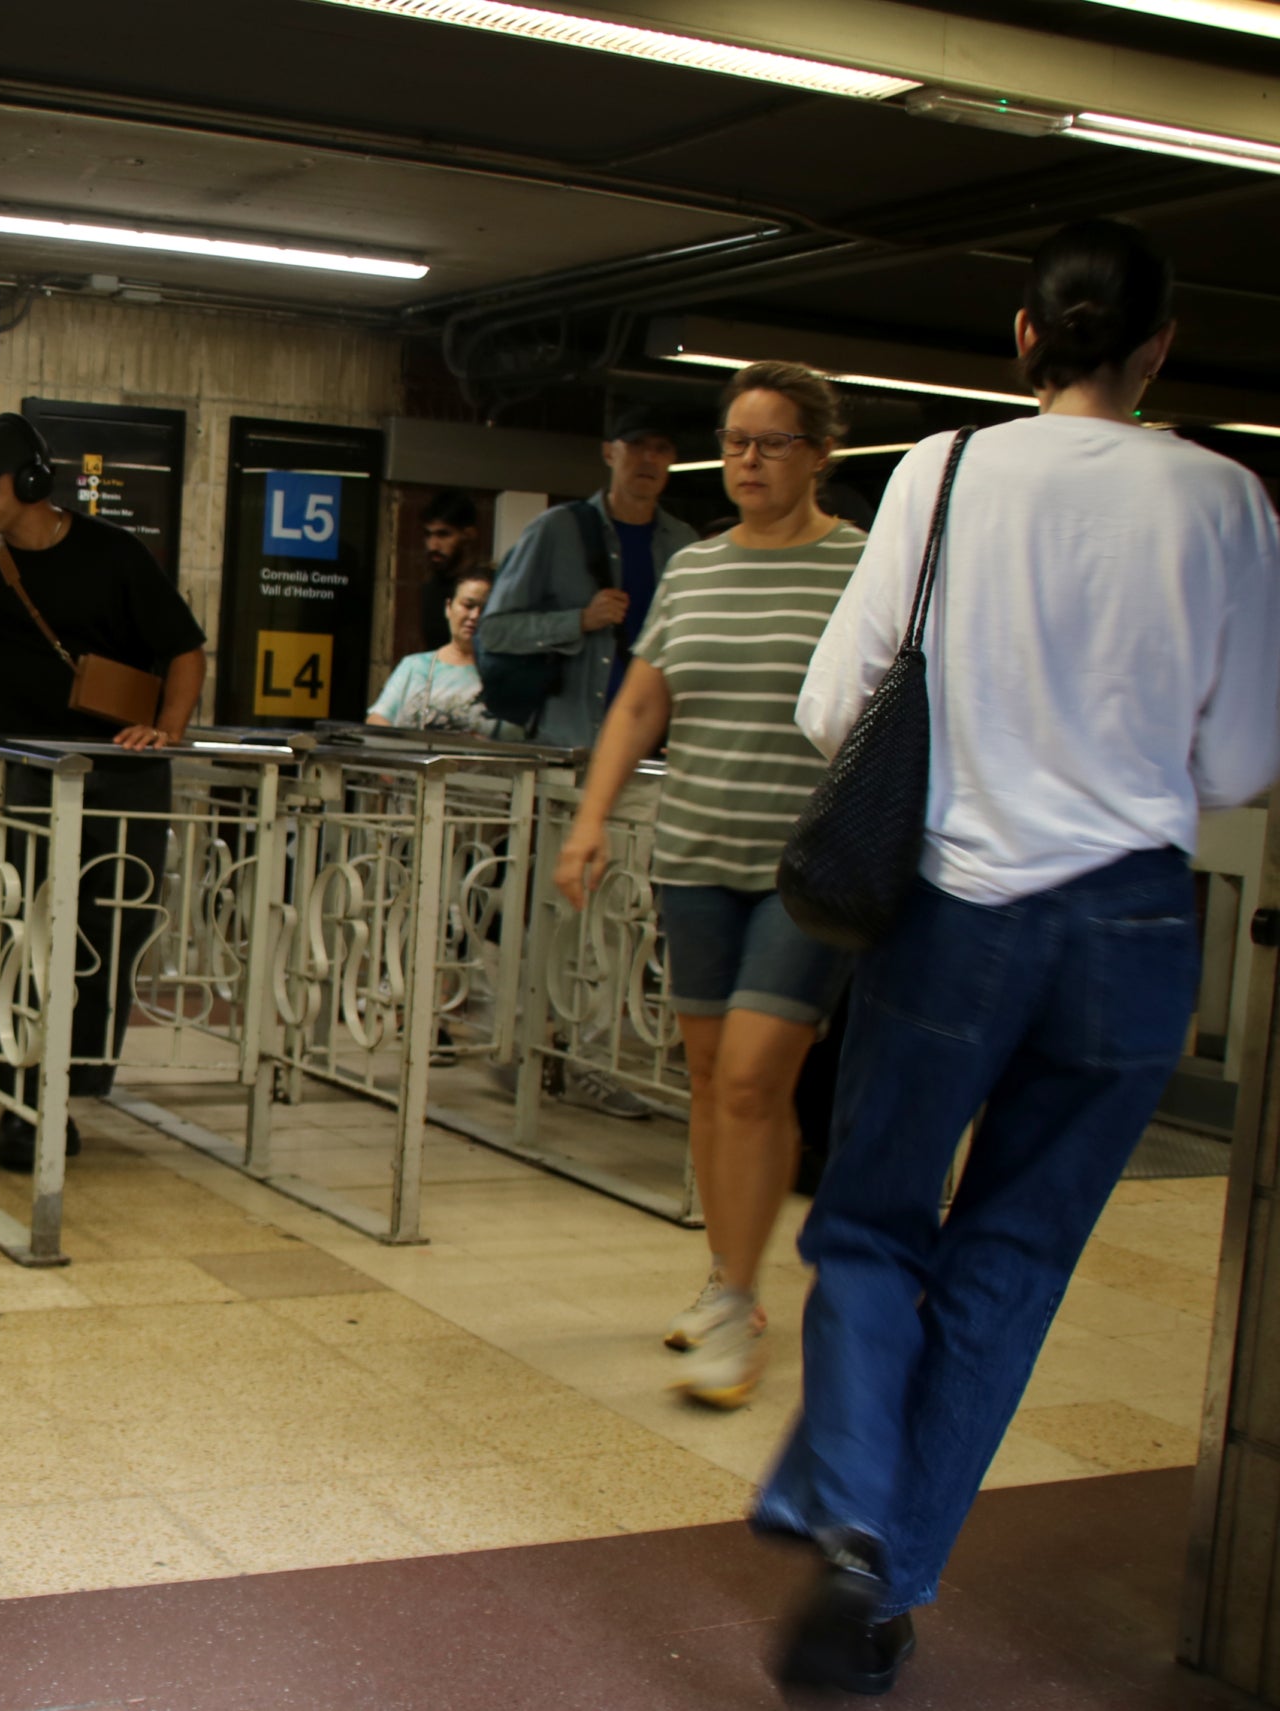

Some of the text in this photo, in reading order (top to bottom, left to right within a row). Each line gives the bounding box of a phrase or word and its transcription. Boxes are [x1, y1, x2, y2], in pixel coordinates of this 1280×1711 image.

[271, 490, 334, 542] L5
[261, 567, 349, 586] Cornellà Centre
[261, 583, 334, 600] Vall d'Hebron
[262, 649, 324, 699] L4
